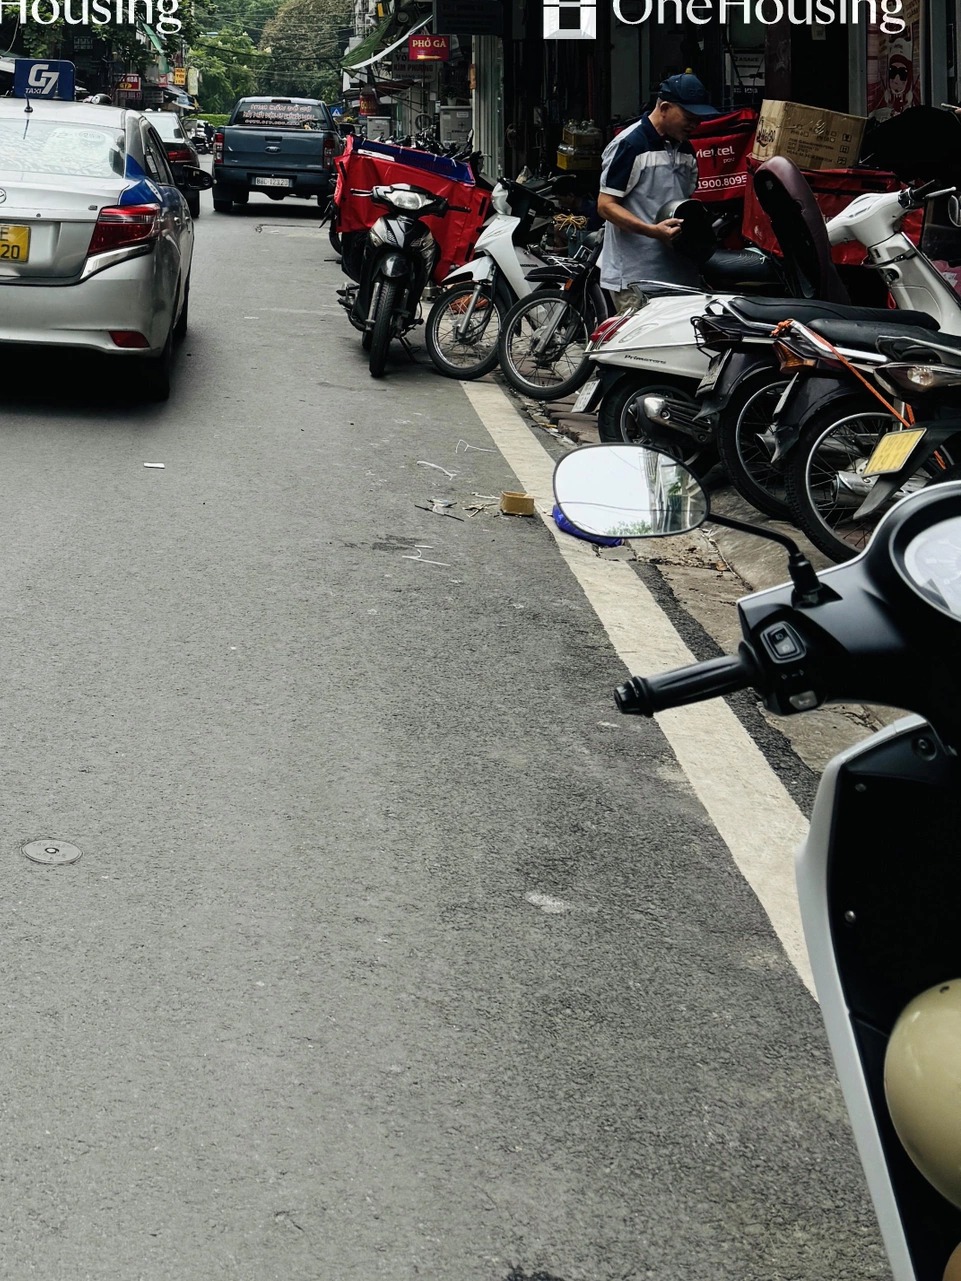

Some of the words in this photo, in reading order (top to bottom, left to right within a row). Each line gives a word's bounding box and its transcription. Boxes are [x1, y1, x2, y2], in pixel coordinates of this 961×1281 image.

[412, 37, 431, 47] PHỞ
[433, 38, 447, 48] GÀ
[28, 64, 60, 95] G7
[697, 175, 747, 189] 1900.8095
